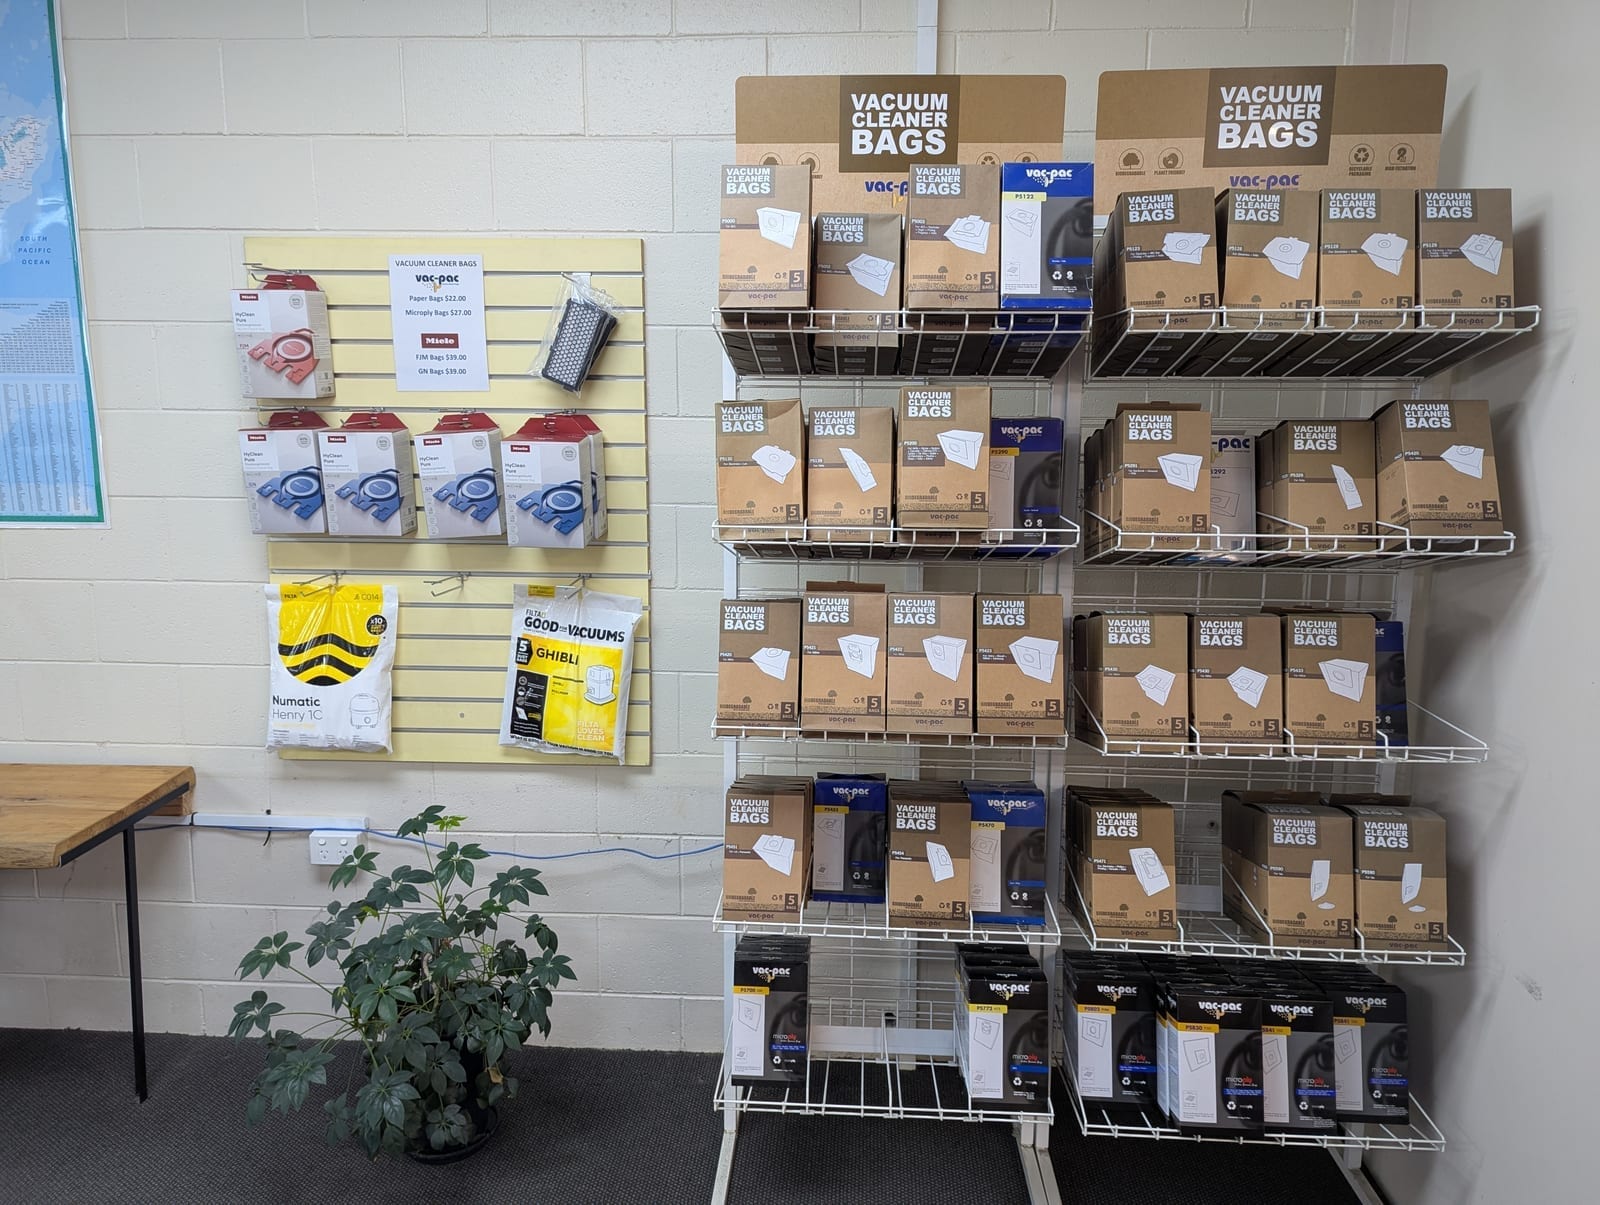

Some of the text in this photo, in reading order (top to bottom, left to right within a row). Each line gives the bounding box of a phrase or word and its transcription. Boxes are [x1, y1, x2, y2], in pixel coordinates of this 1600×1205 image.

[1221, 85, 1322, 103] VACUUM
[851, 94, 948, 110] VACUUM
[1220, 104, 1321, 120] CLEANER
[852, 112, 948, 127] CLEANER
[1218, 122, 1318, 149] BAGS
[852, 130, 946, 154] BAGS
[1026, 169, 1072, 181] vac-pac
[1230, 175, 1299, 189] vac-pac
[726, 183, 770, 194] BAGS
[865, 181, 908, 196] vac-p
[916, 183, 961, 194] BAGS
[1128, 194, 1174, 203] VACUUM
[1235, 194, 1280, 202] VACUUM
[1129, 202, 1174, 210] CLEANER
[1129, 209, 1174, 222] BAGS
[1235, 210, 1280, 222] BAGS
[1329, 208, 1376, 219] BAGS
[1426, 207, 1473, 218] BAGS
[823, 232, 864, 242] BAGS
[416, 275, 459, 284] vac-pac
[908, 407, 952, 417] BAGS
[722, 421, 764, 432] BAGS
[1406, 418, 1451, 428] BAGS
[814, 425, 855, 435] BAGS
[1001, 426, 1043, 437] vac-pac
[1129, 429, 1172, 440] BAGS
[1294, 440, 1337, 450] BAGS
[974, 494, 982, 503] 5
[1487, 503, 1494, 512] 5
[808, 612, 849, 622] BAGS
[894, 614, 936, 624] BAGS
[983, 615, 1025, 626] BAGS
[524, 616, 625, 642] GOOD VACUUMS
[724, 620, 764, 630] BAGS
[1108, 634, 1151, 644] BAGS
[1200, 635, 1243, 646] BAGS
[1294, 635, 1337, 646] BAGS
[519, 640, 527, 652] 5
[536, 648, 579, 665] GHIBLI
[273, 696, 320, 707] Numatic
[272, 710, 323, 722] Henry 1C
[833, 788, 869, 797] vac-pac
[896, 805, 936, 813] VACUUM
[988, 800, 1027, 810] vac-pac
[730, 813, 769, 823] BAGS
[1273, 819, 1316, 828] VACUUM
[896, 819, 936, 830] BAGS
[1364, 822, 1408, 831] VACUUM
[1097, 826, 1138, 837] BAGS
[1273, 834, 1316, 845] BAGS
[1365, 837, 1409, 848] BAGS
[752, 967, 790, 978] vac-pac
[990, 984, 1030, 995] vac-pac
[1097, 985, 1137, 996] vac-pac
[1198, 1002, 1242, 1013] vac-pac
[1345, 997, 1388, 1007] vac-pac
[1271, 1005, 1314, 1016] vac-pac
